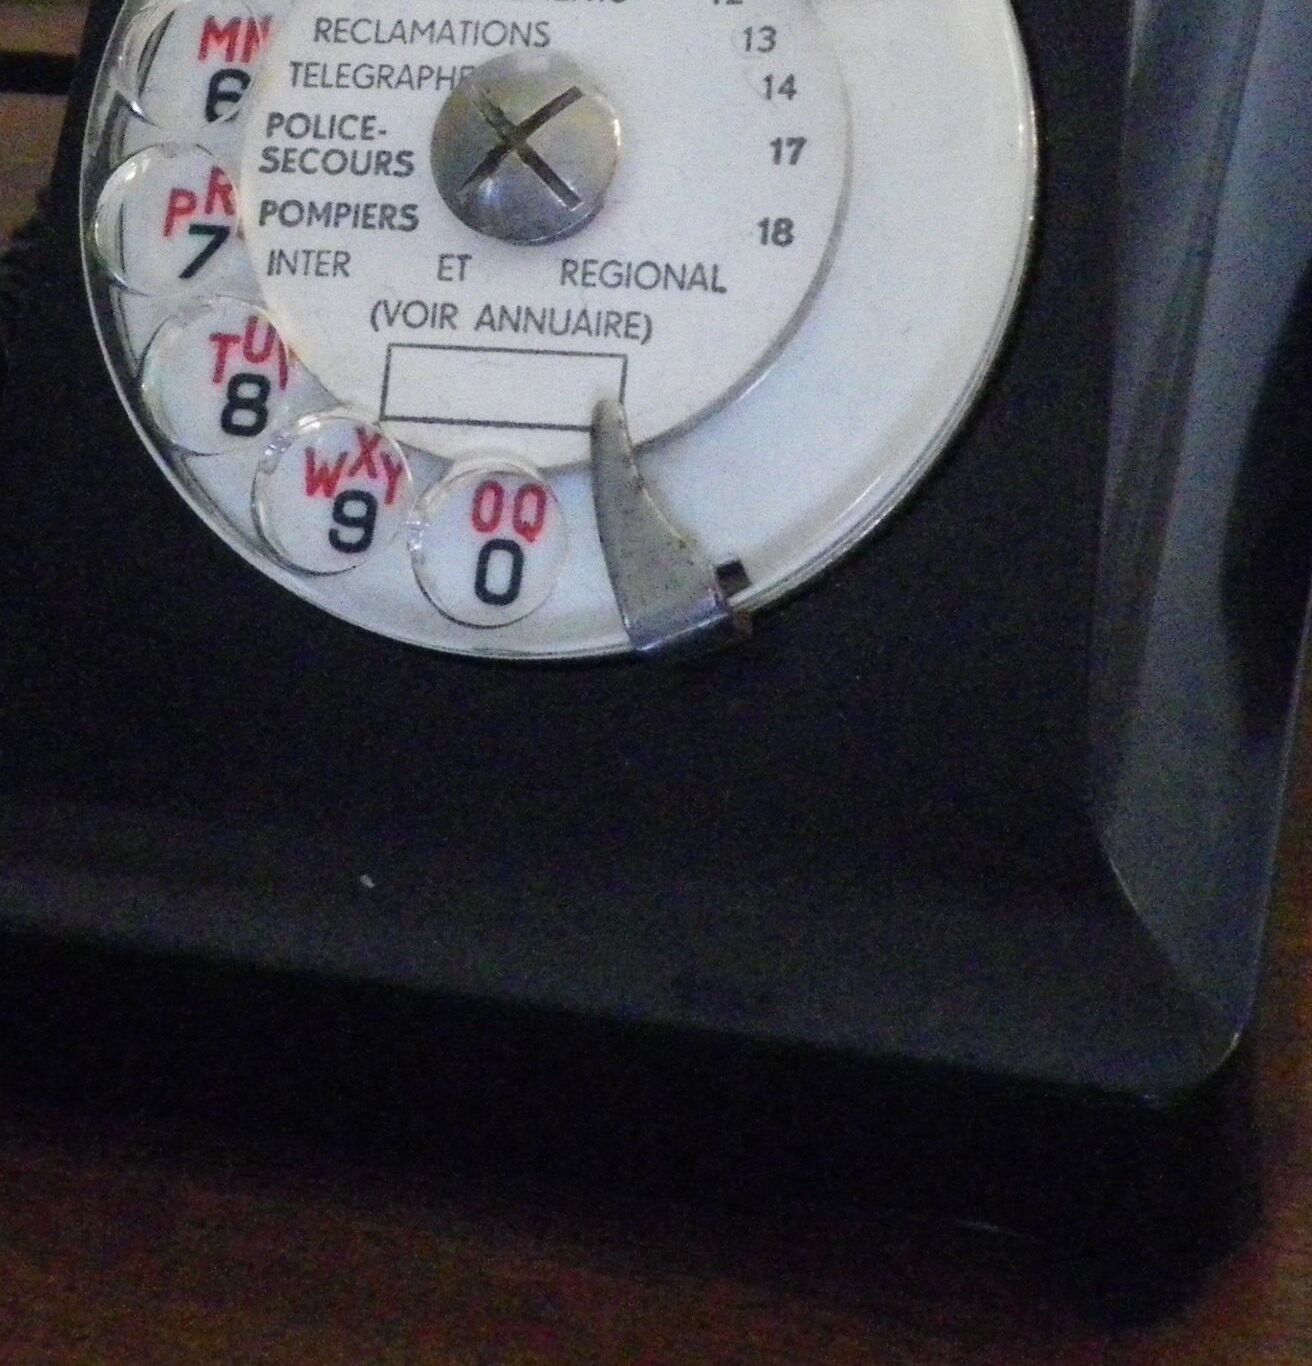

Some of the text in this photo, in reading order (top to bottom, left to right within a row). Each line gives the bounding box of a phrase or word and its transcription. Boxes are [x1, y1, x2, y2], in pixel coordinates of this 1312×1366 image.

[313, 16, 777, 52] RECLAMATIONS 13
[764, 73, 797, 101] 14
[265, 112, 387, 140] POLICE-
[258, 137, 807, 178] SECOURS 17
[258, 199, 795, 247] POMPIERS 18
[178, 223, 230, 279] 7
[267, 249, 728, 294] INTER ET REGIONAL
[370, 298, 653, 346] (VOIR ANNUAIRE)
[220, 372, 271, 438] 8
[304, 426, 404, 506] WXY
[328, 489, 378, 554] 9
